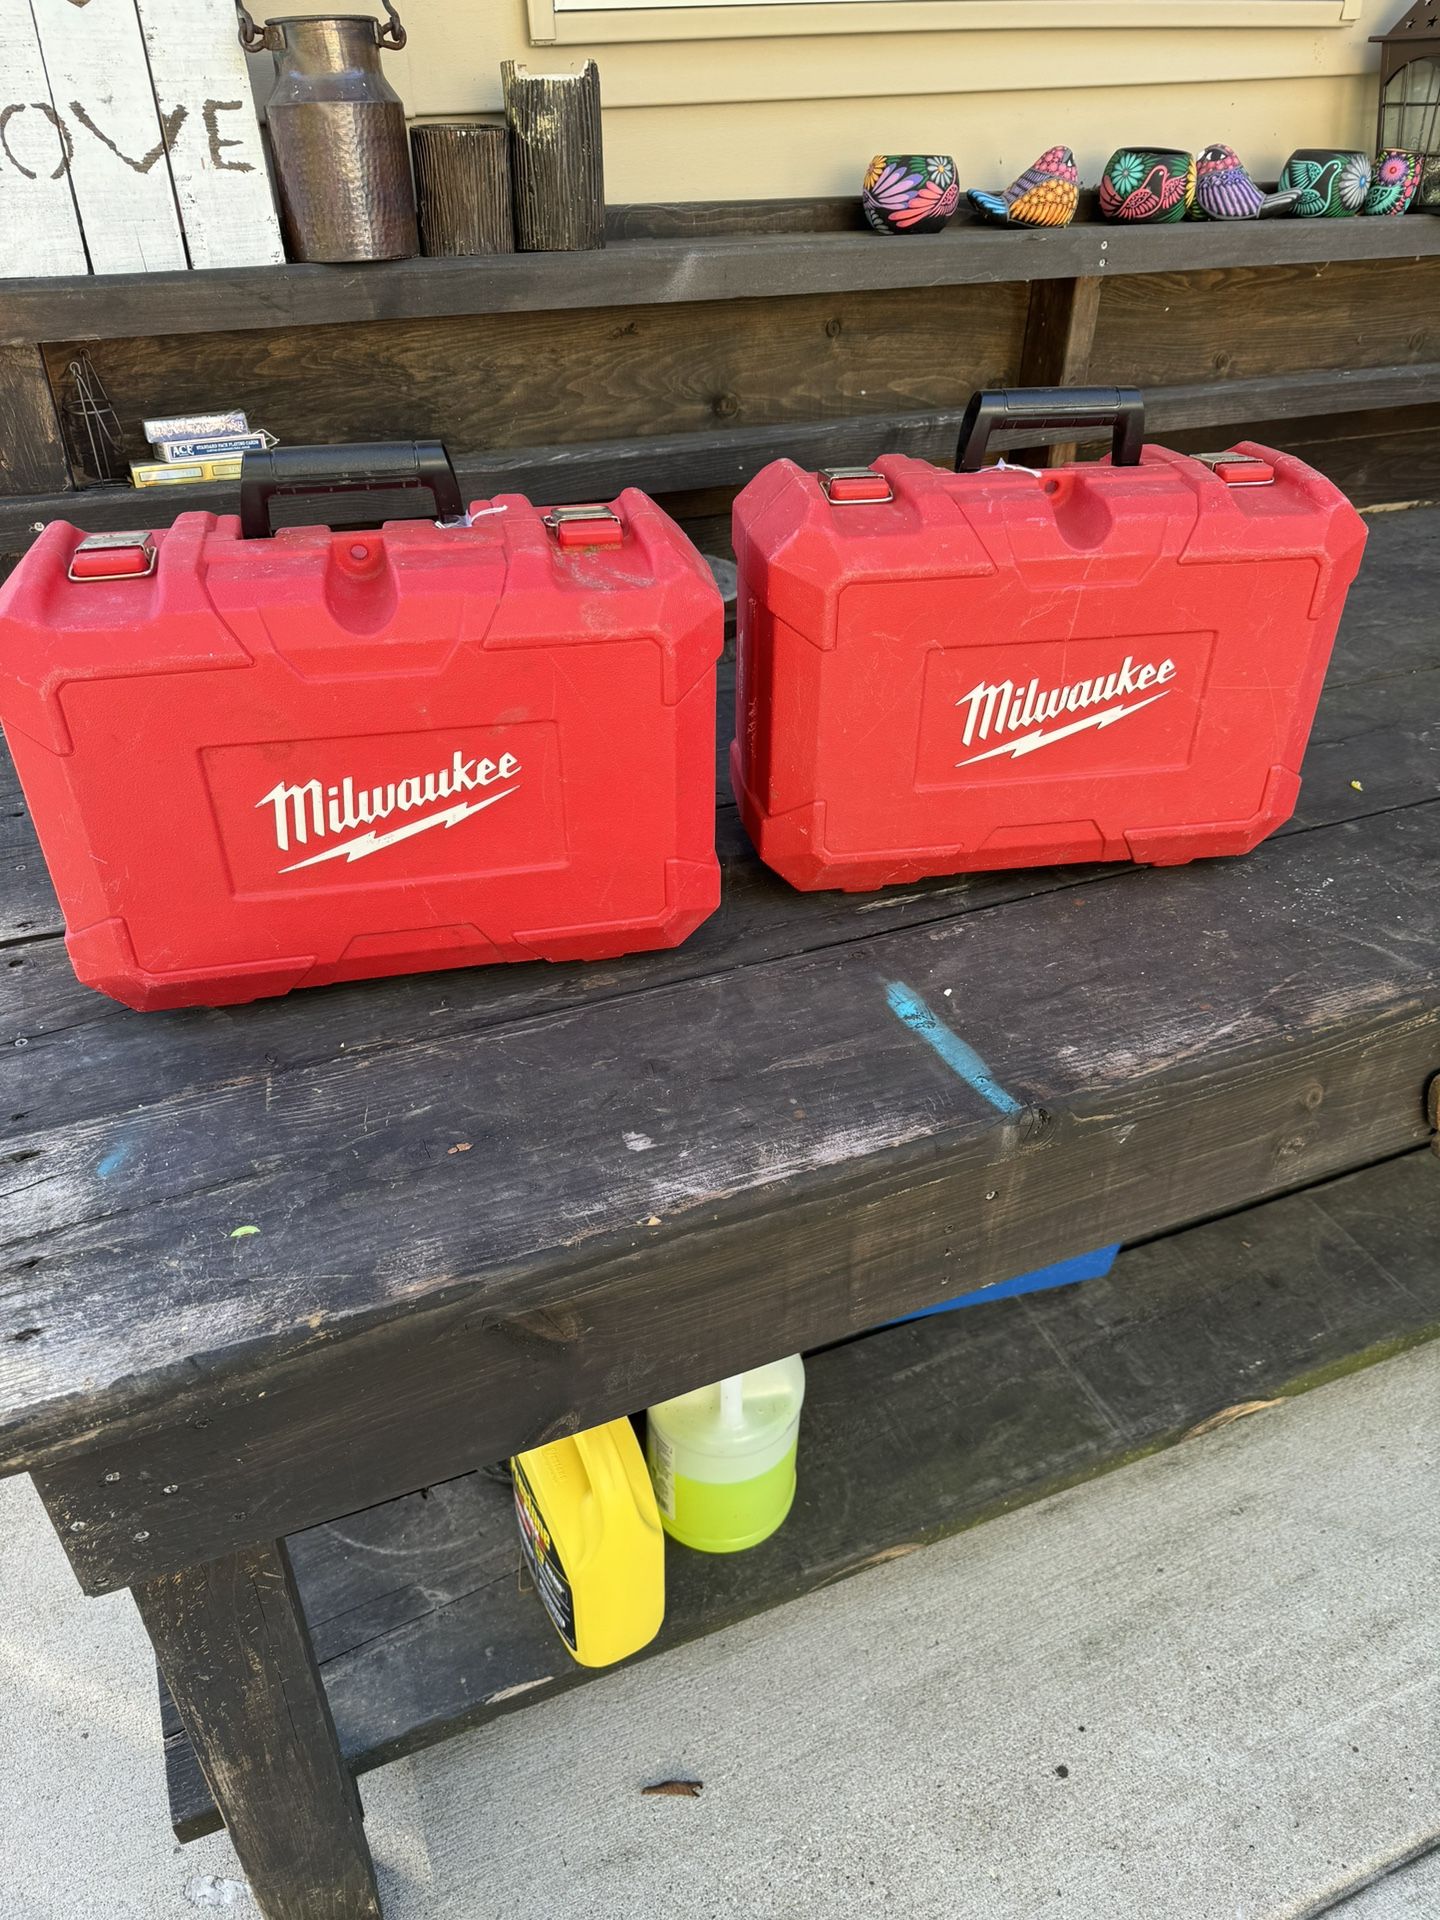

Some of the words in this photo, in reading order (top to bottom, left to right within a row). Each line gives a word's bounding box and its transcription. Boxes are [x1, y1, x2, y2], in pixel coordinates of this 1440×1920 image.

[0, 99, 256, 180] OVE
[172, 445, 194, 459] ACE
[228, 440, 246, 448] PLAYING
[955, 656, 1177, 747] Milwaukee
[254, 751, 522, 851] Milwaukee
